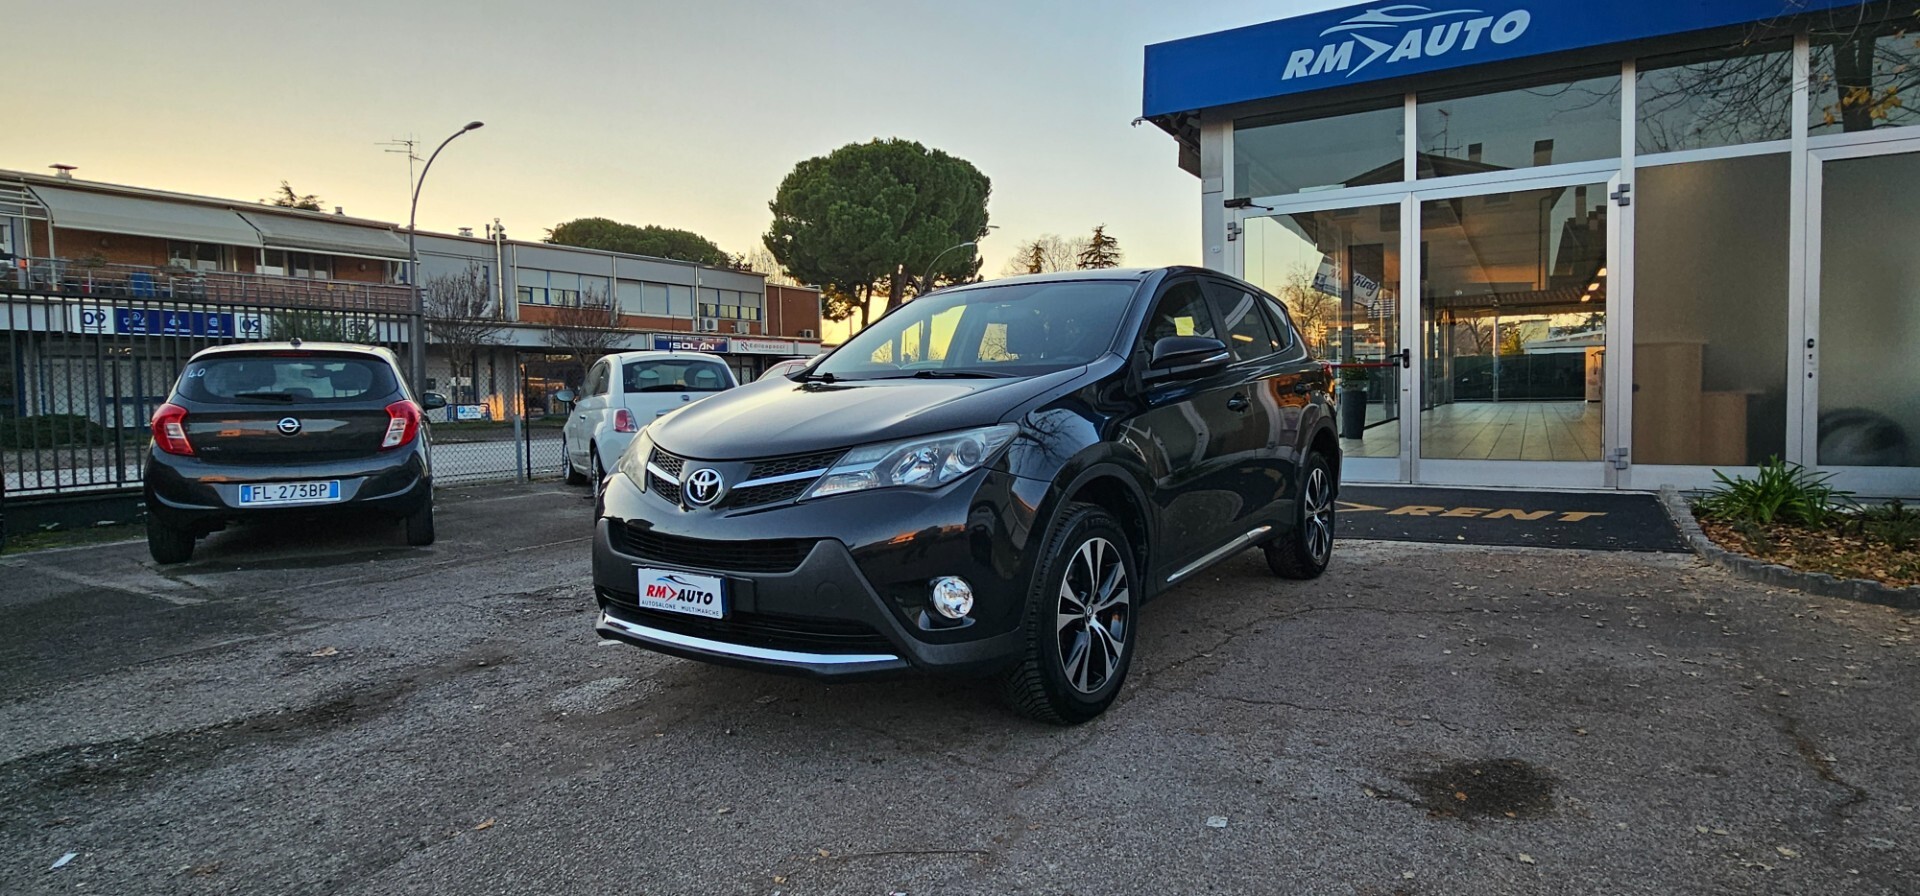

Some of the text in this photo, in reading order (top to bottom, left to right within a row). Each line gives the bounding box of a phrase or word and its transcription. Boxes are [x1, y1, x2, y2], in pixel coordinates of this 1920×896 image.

[1386, 9, 1531, 64] AUTO
[669, 342, 715, 352] ISOLAN
[1386, 505, 1608, 522] RENT
[677, 588, 713, 605] AUTO
[641, 600, 719, 617] AUTOSALONE MULTIMARCHE
